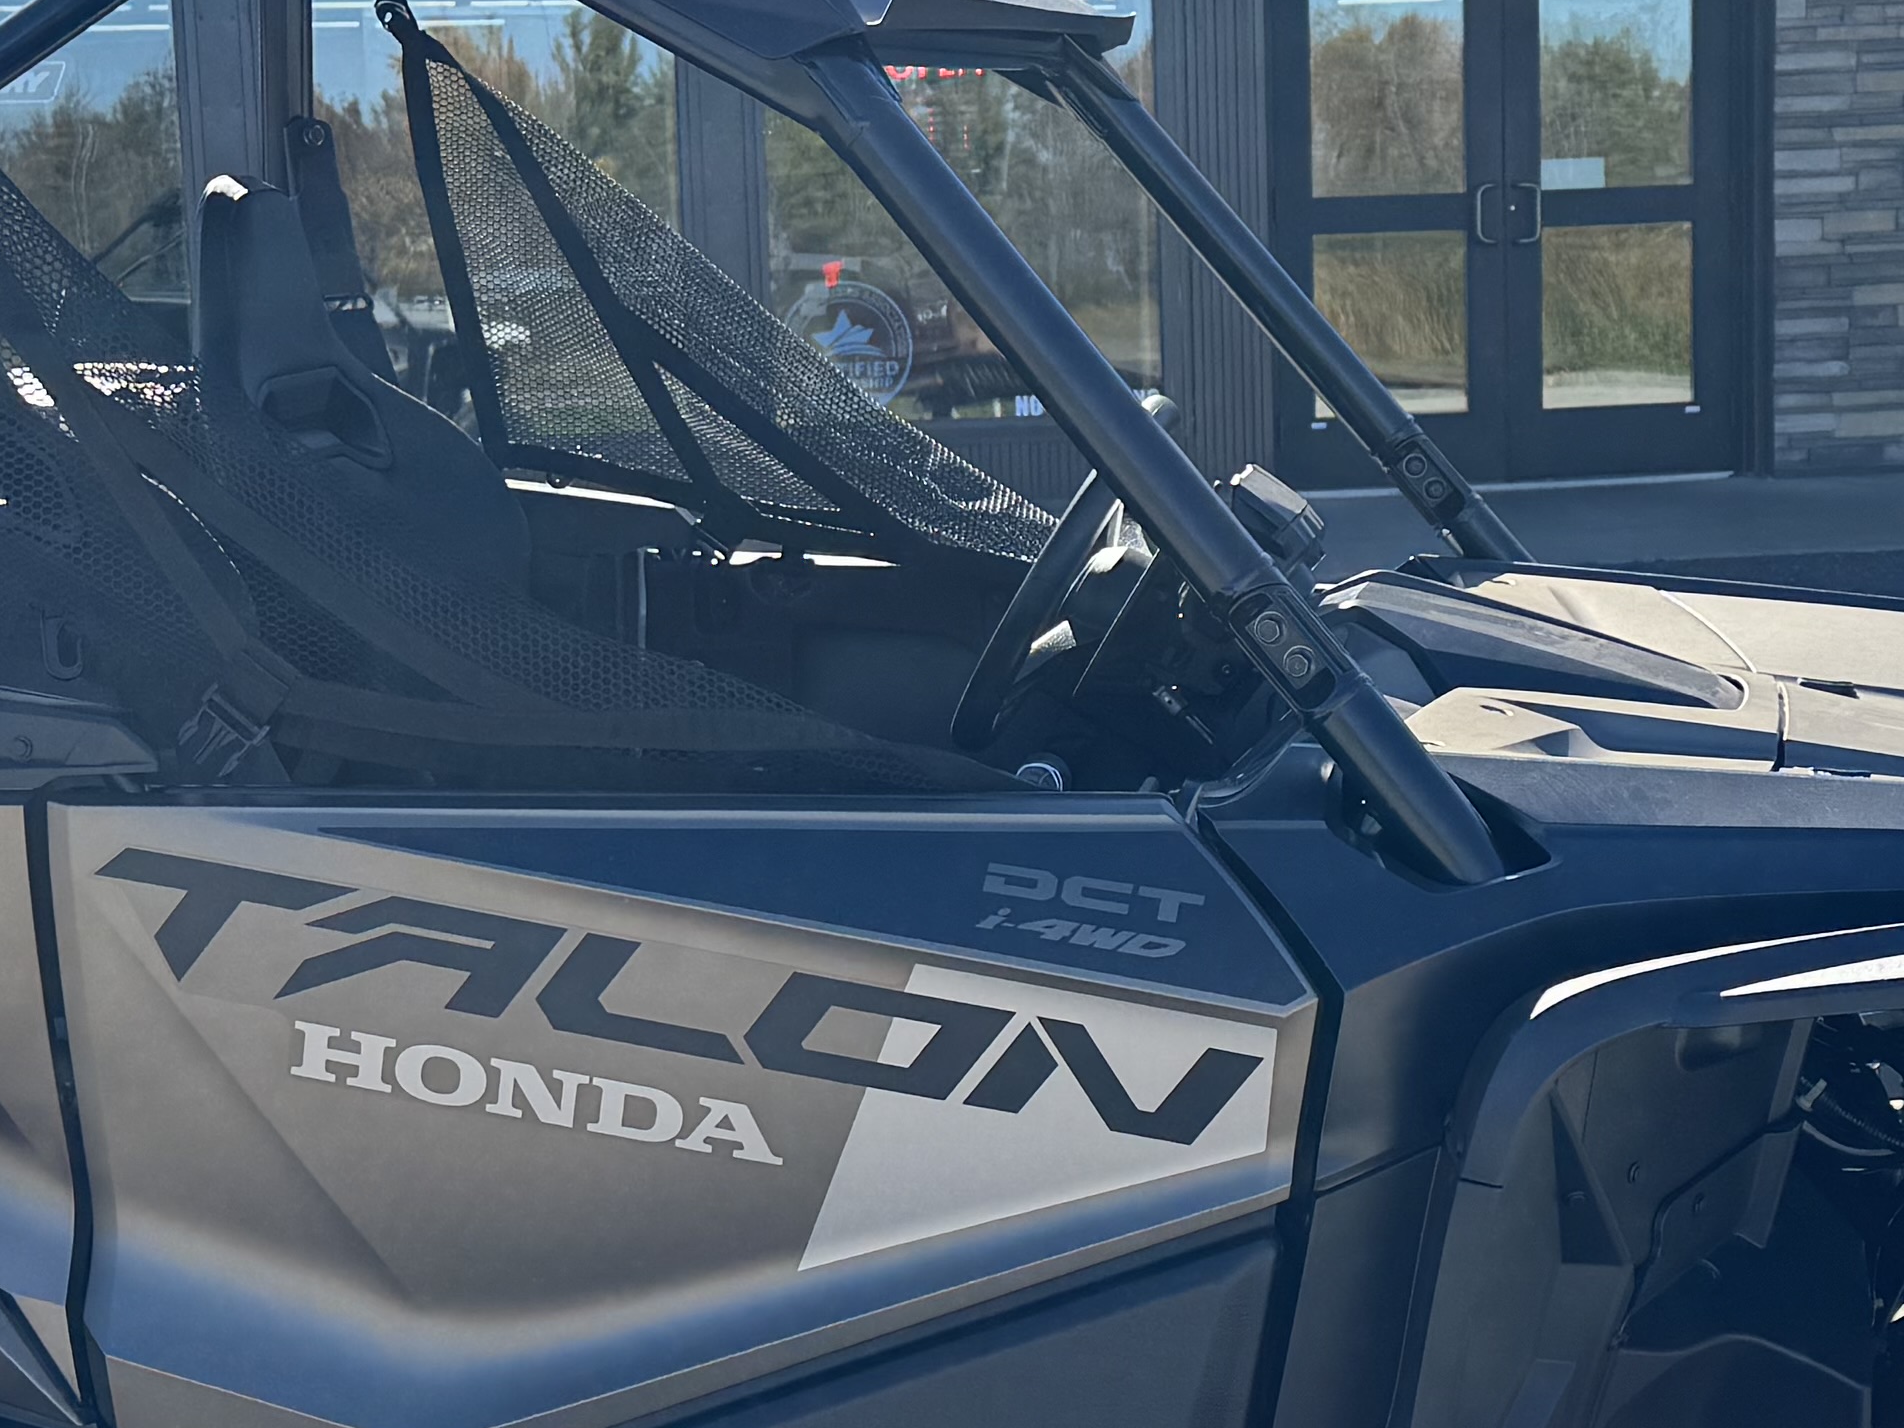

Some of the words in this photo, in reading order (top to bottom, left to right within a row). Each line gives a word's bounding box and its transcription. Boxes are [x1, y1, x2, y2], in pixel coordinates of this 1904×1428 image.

[976, 907, 1187, 958] i-4WD
[983, 862, 1205, 923] DCT
[95, 847, 1264, 1146] TALON
[290, 1020, 783, 1167] HONDA
